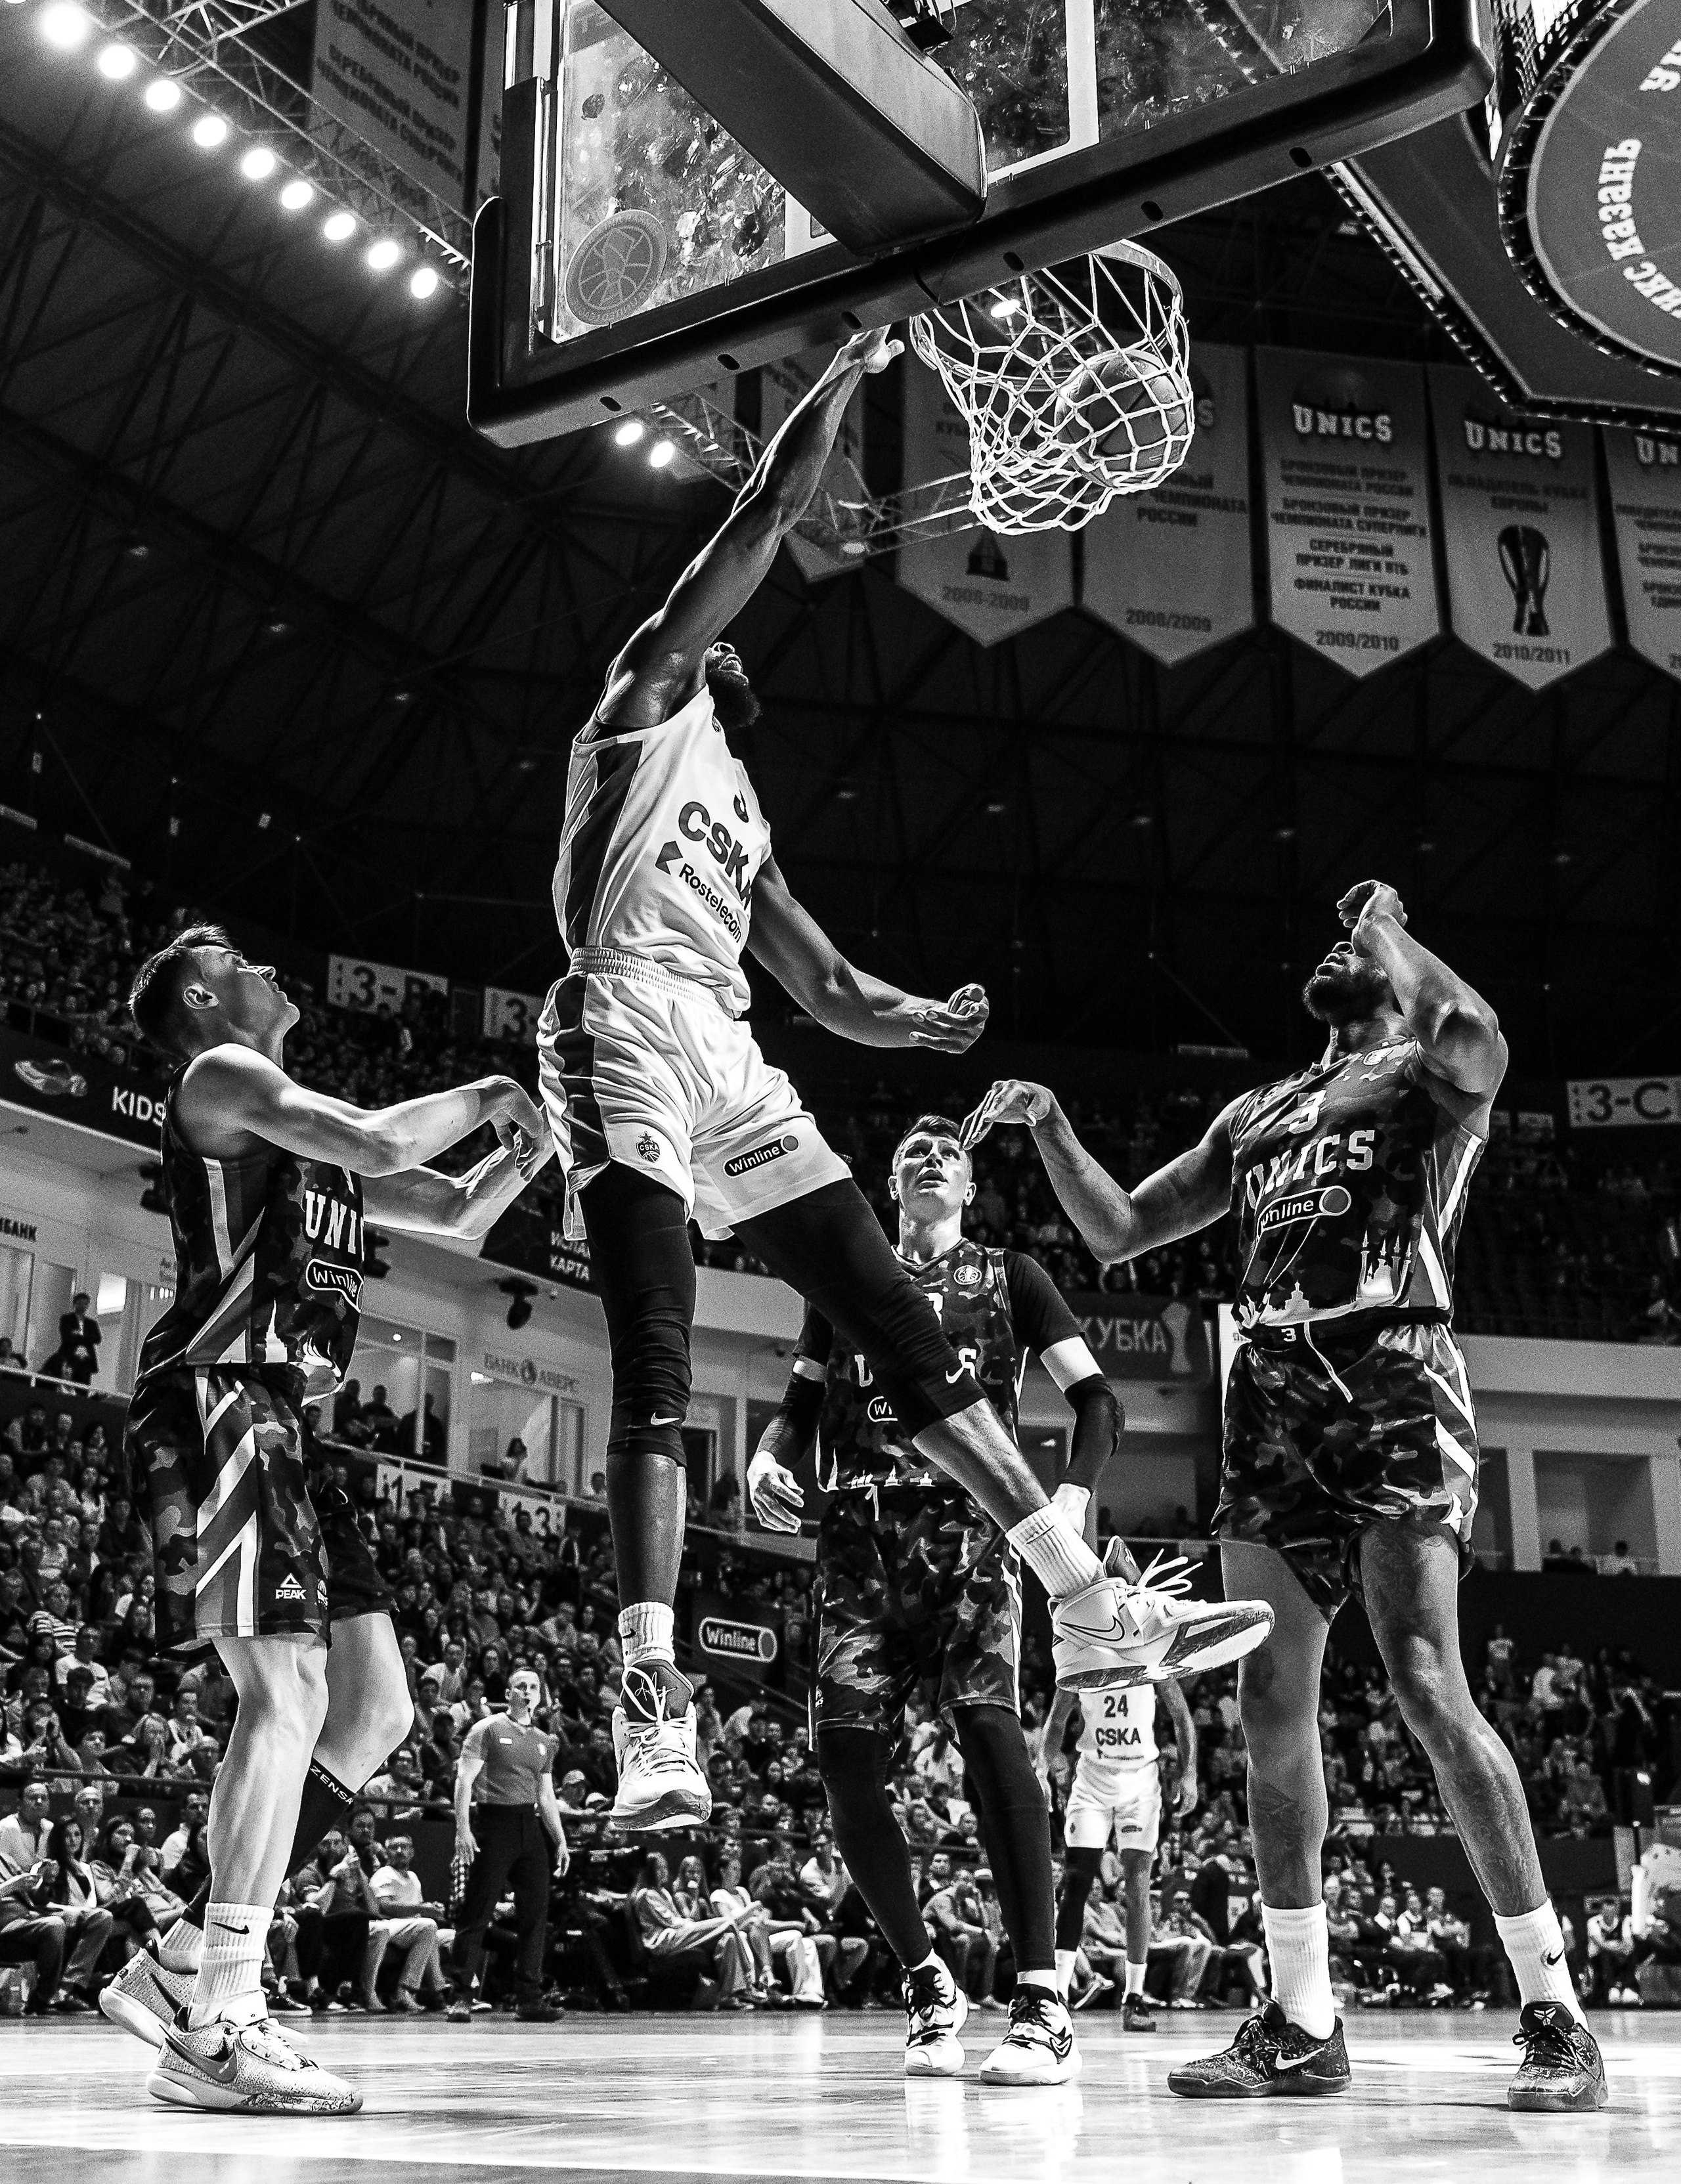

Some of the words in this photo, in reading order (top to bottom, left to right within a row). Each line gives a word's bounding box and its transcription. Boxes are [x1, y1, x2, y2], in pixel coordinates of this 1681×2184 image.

[1292, 403, 1393, 443] UNICS
[1464, 420, 1562, 460] UNICS
[1315, 630, 1400, 651] 2009/2010
[1493, 642, 1571, 665] 2010/2011
[679, 863, 742, 944] Rostelecom
[112, 1085, 166, 1127] KIDS
[729, 1146, 781, 1173] Winline
[305, 1190, 365, 1262] UNI
[550, 1254, 590, 1282] КАРТА
[313, 1267, 358, 1298] Winline
[1281, 1328, 1296, 1342] 3
[484, 1353, 519, 1378] БАНК
[275, 1589, 307, 1600] PEAK
[706, 1626, 756, 1652] Winline
[1104, 1694, 1129, 1717] 24
[1095, 1727, 1141, 1747] CSKA
[310, 1765, 354, 1805] ZENSA
